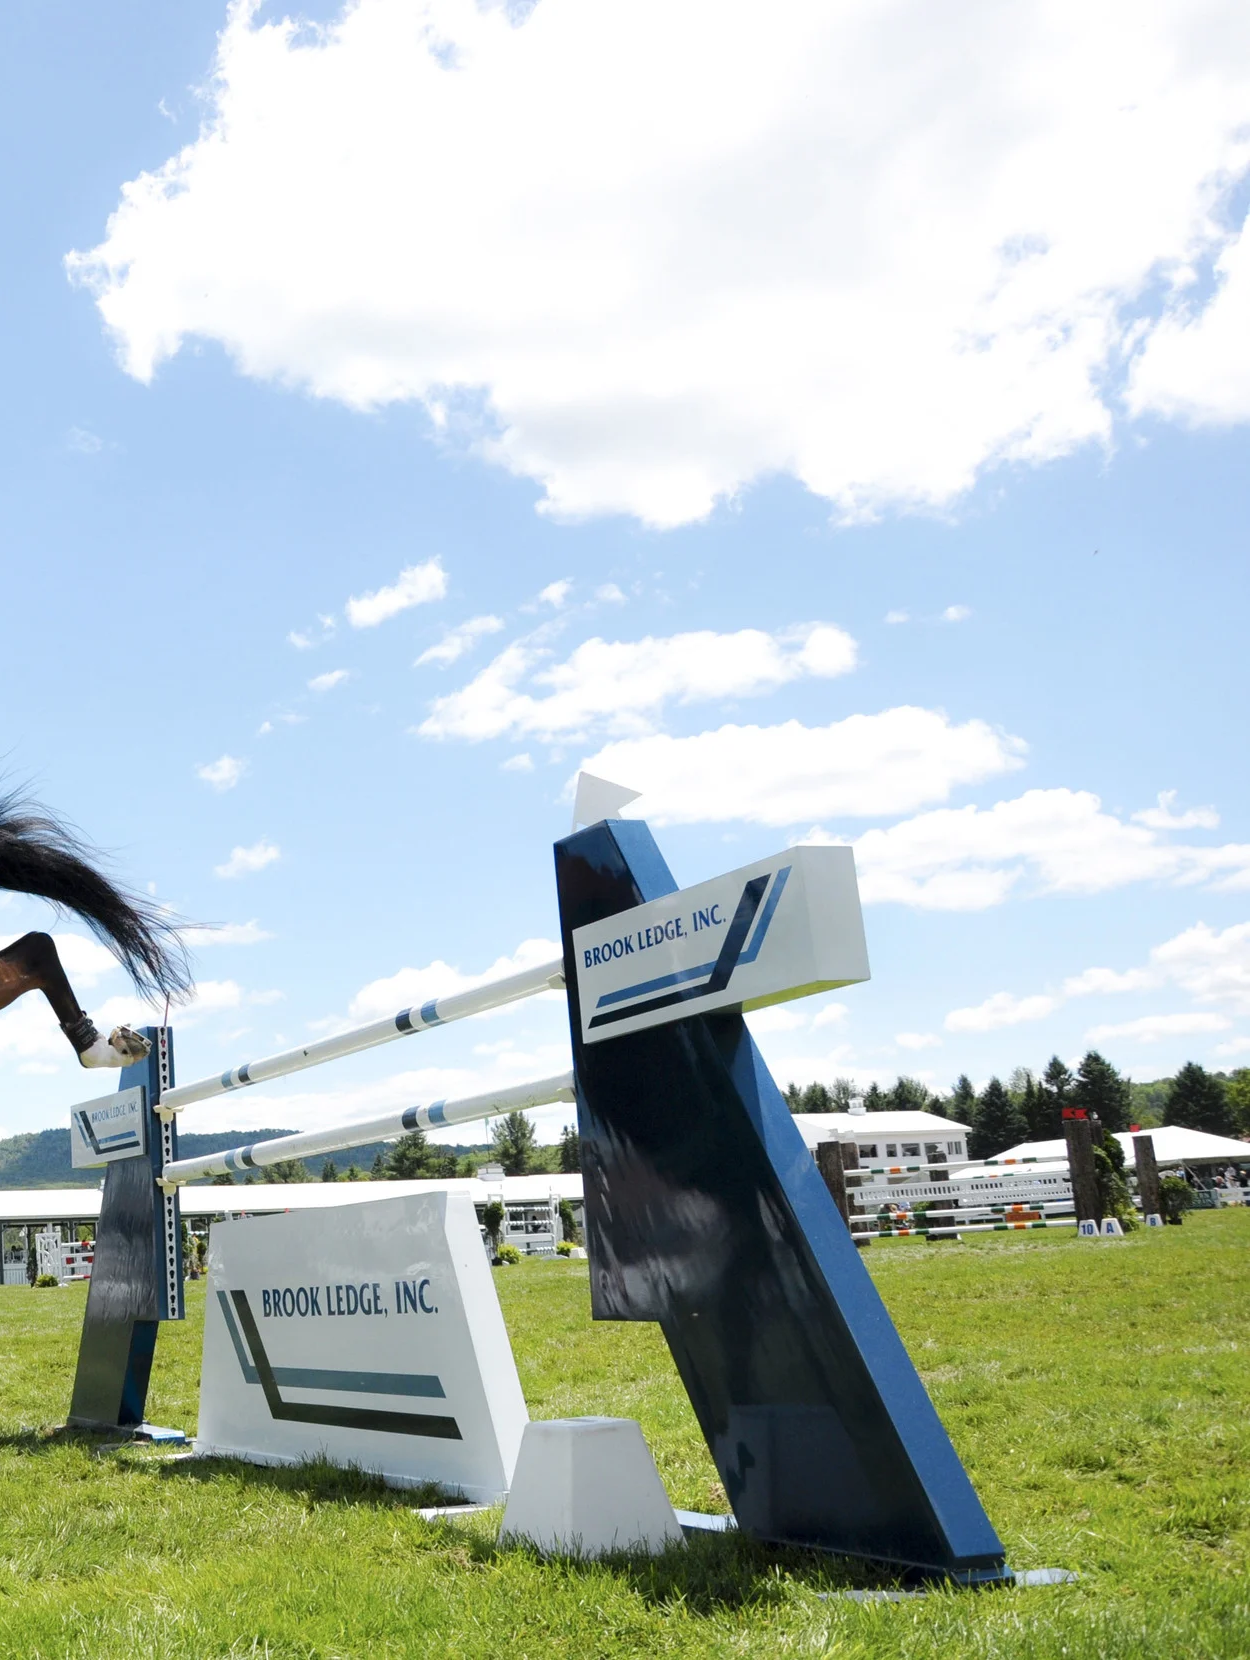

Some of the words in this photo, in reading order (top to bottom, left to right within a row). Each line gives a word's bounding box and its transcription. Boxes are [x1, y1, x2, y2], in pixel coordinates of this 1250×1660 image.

[583, 934, 635, 969] BROOK
[637, 917, 688, 951] LEDGE,
[692, 903, 727, 933] INC.
[91, 1110, 110, 1124] BROOK
[1106, 1222, 1115, 1234] A
[1150, 1217, 1157, 1227] B
[1081, 1223, 1094, 1235] 10
[262, 1286, 322, 1318] BROOK
[326, 1282, 388, 1318] LEDGE,
[395, 1278, 439, 1315] INC.
